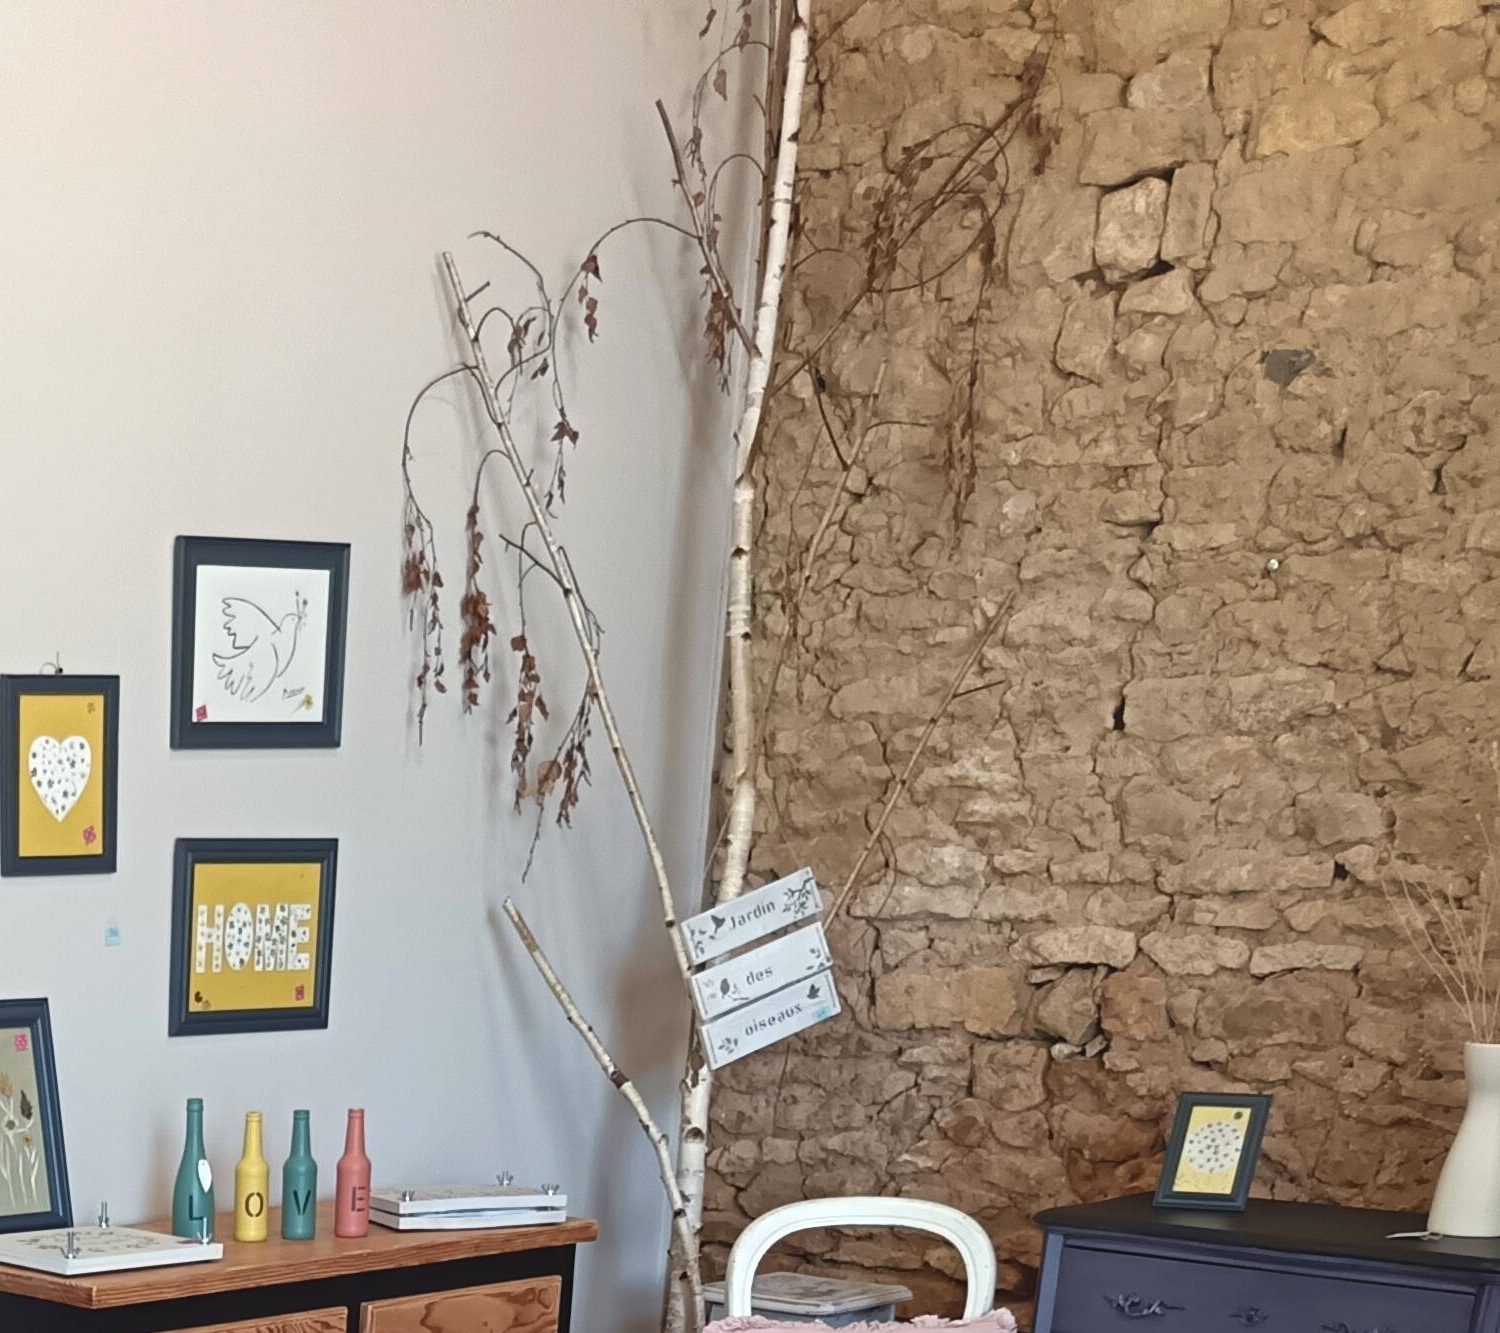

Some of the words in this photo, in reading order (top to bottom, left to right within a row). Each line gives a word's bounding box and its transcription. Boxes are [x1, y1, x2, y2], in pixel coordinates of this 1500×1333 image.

[729, 901, 776, 930] Jardin
[195, 902, 313, 974] HOME
[745, 968, 774, 987] des
[745, 1003, 802, 1036] oiseaux
